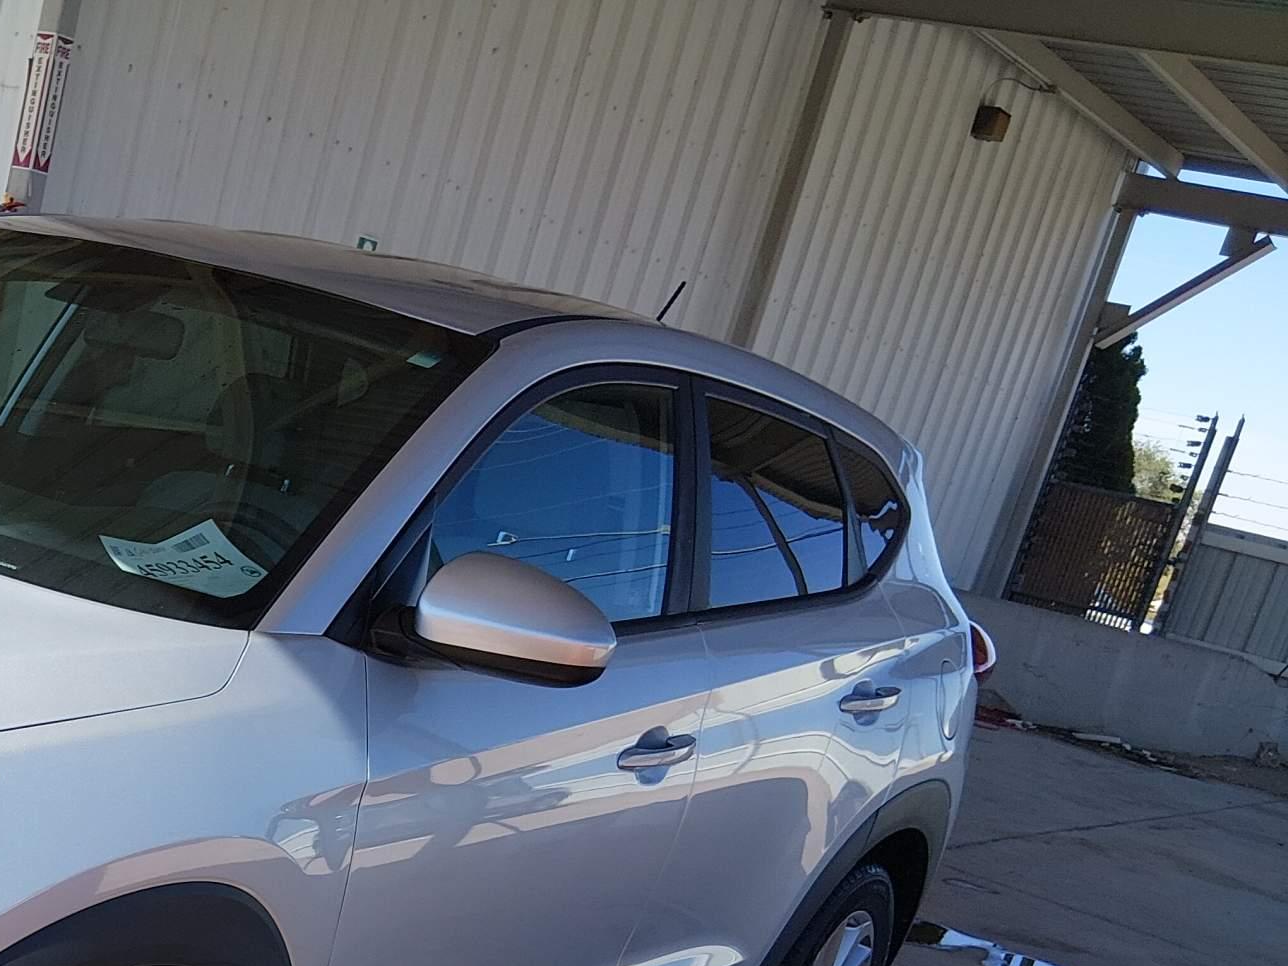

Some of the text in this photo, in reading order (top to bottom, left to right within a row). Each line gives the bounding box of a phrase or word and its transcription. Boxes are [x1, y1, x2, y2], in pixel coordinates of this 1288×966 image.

[21, 57, 43, 152] EXTINGUISHER
[41, 62, 64, 158] EXTINGUISHER
[137, 551, 233, 578] 45933454
